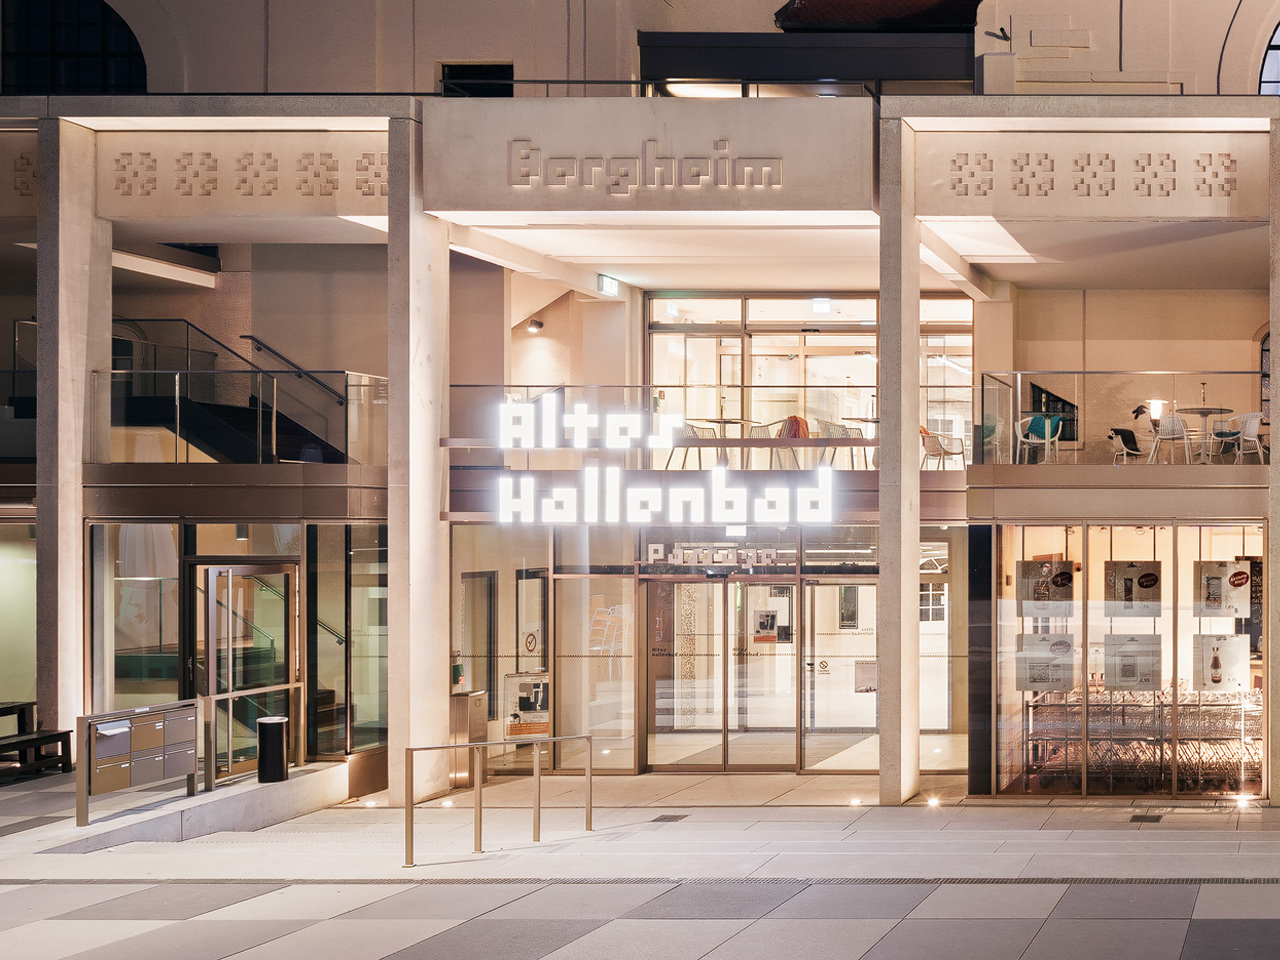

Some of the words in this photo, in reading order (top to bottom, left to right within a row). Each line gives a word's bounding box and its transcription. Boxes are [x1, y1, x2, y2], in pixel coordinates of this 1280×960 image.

[507, 139, 783, 196] Bergheim
[500, 392, 684, 448] Altes
[499, 466, 833, 522] Hallenbad
